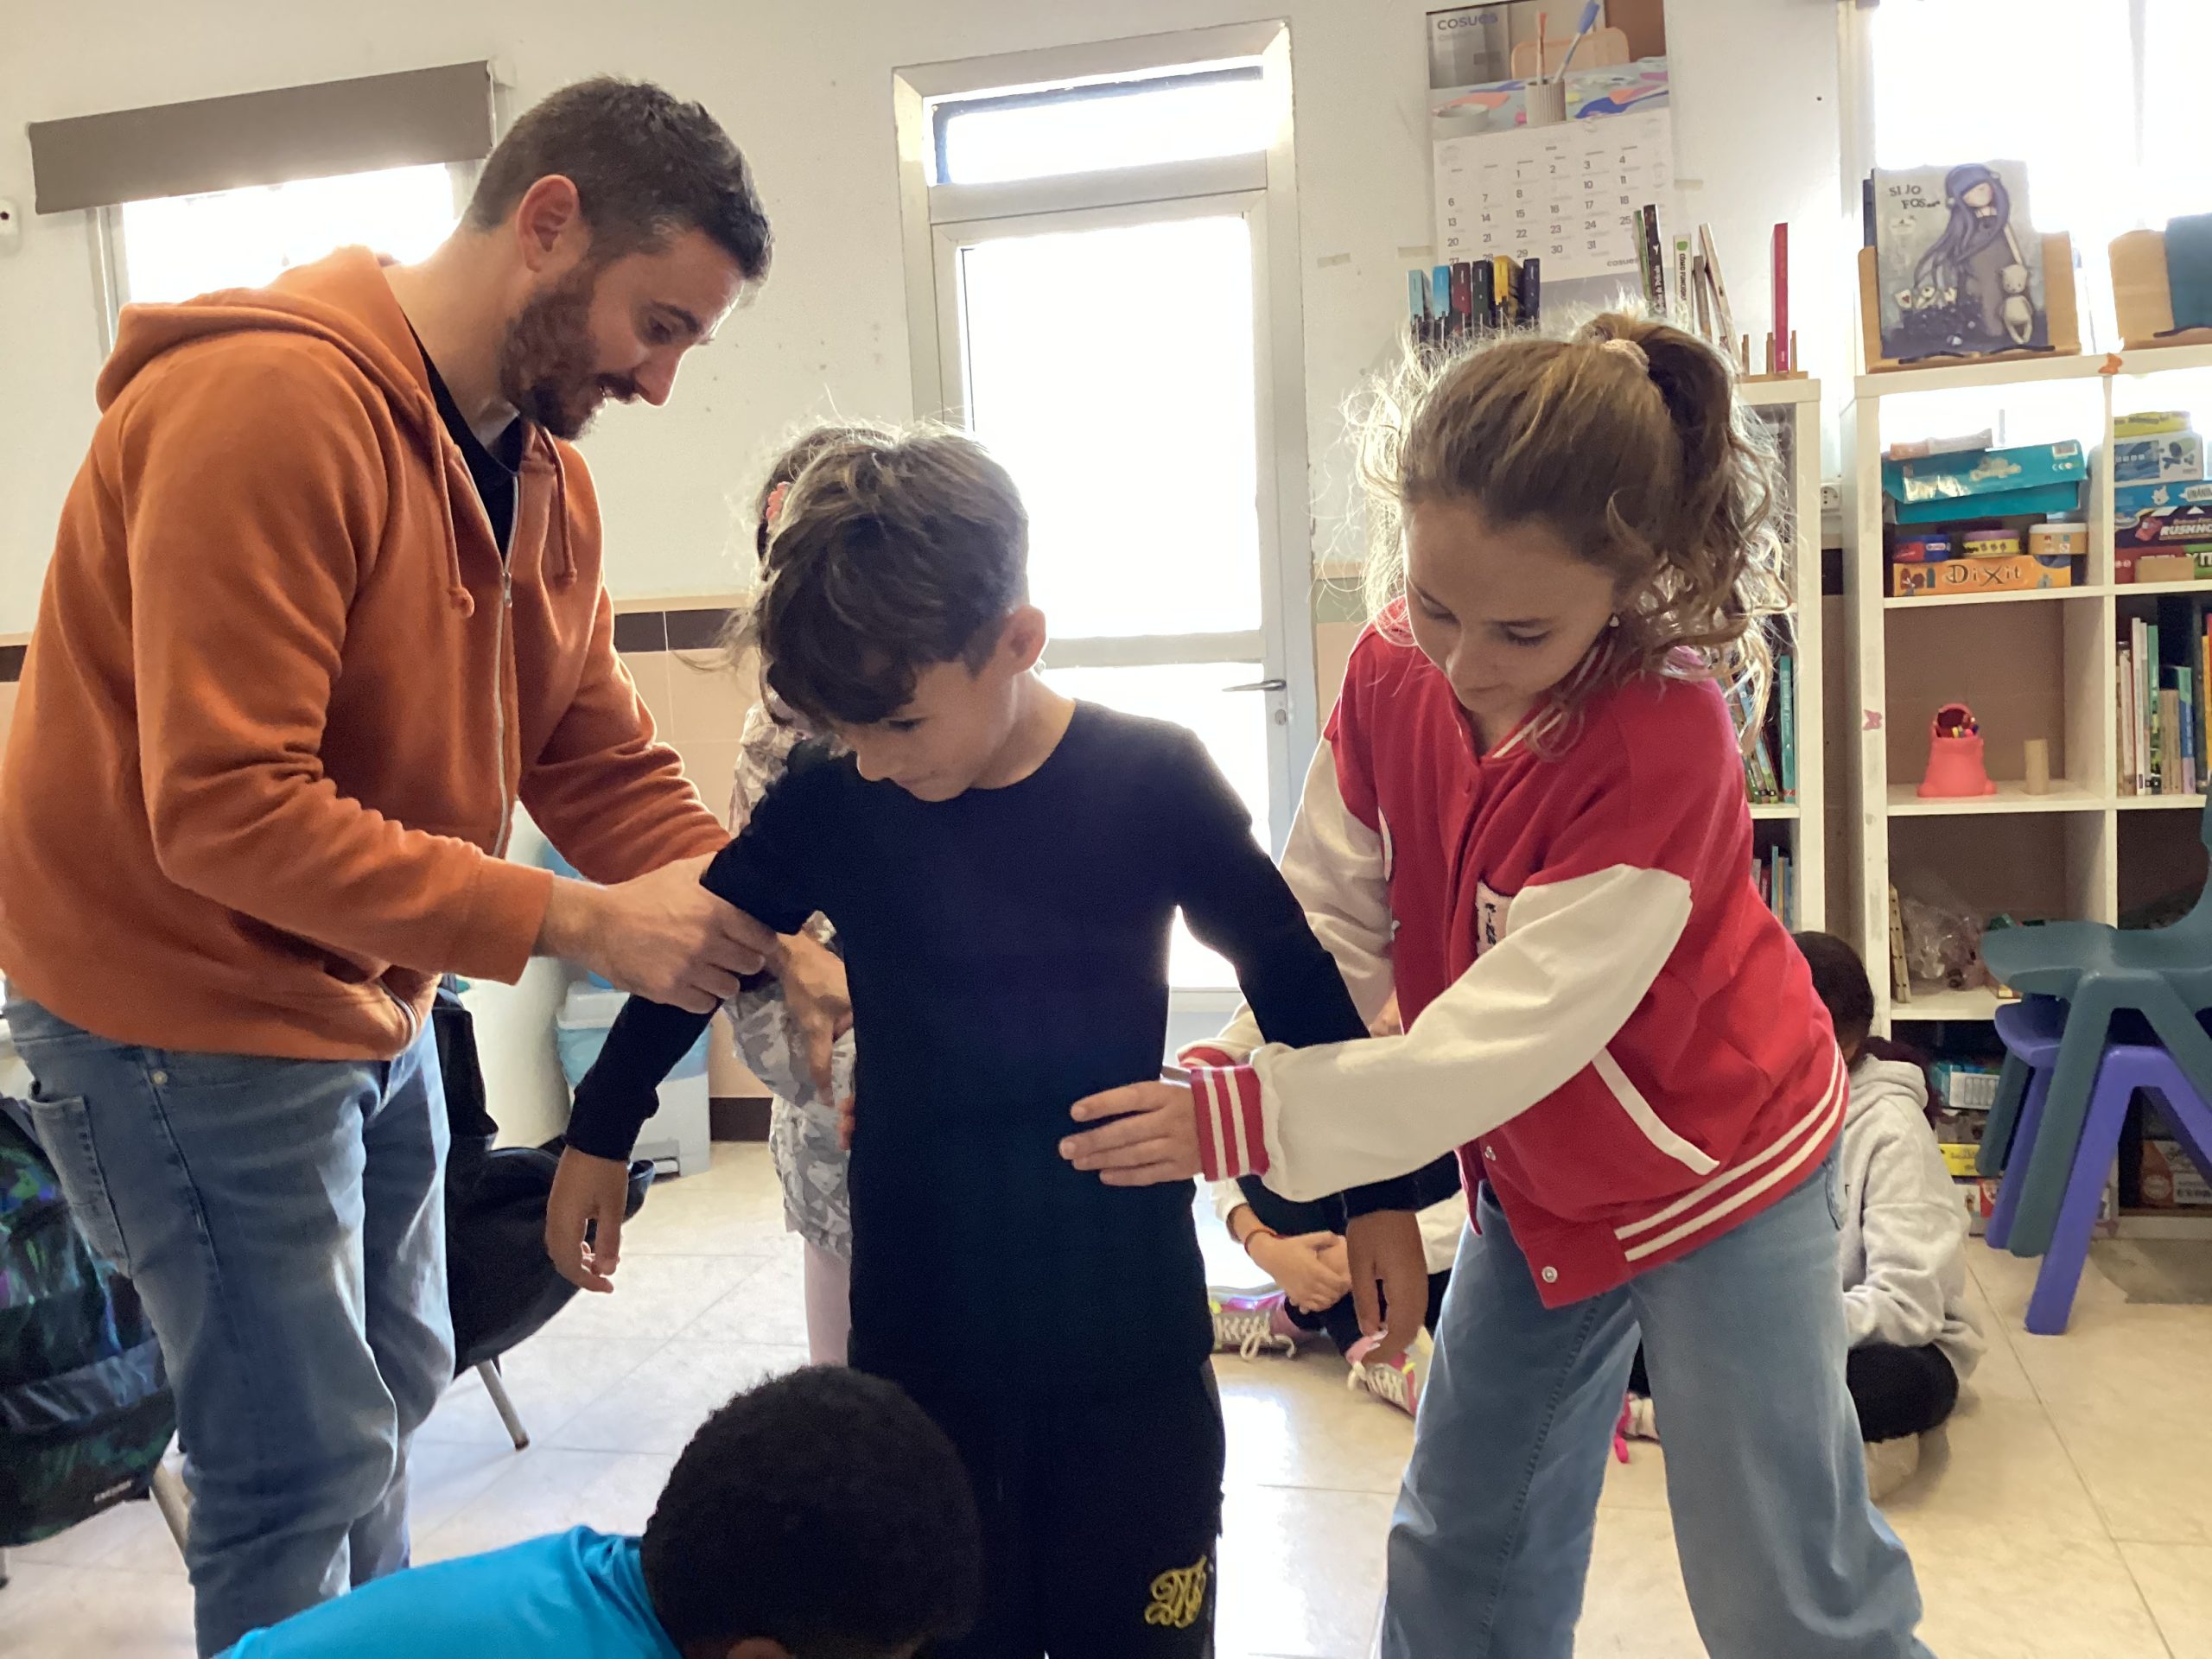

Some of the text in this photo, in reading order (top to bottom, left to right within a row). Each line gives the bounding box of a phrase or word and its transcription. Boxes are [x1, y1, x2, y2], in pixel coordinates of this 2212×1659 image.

[1516, 155, 1626, 178] 1 2 3 4
[1448, 175, 1627, 207] 6 7 8 10 11
[1889, 184, 1922, 197] SI JO
[1447, 195, 1630, 226] 13 14 15 16 17 18
[1447, 216, 1632, 246] 20 21 22 23 24 25
[1516, 249, 1529, 258] 29
[1550, 245, 1563, 254] 30
[1586, 240, 1597, 249] 31
